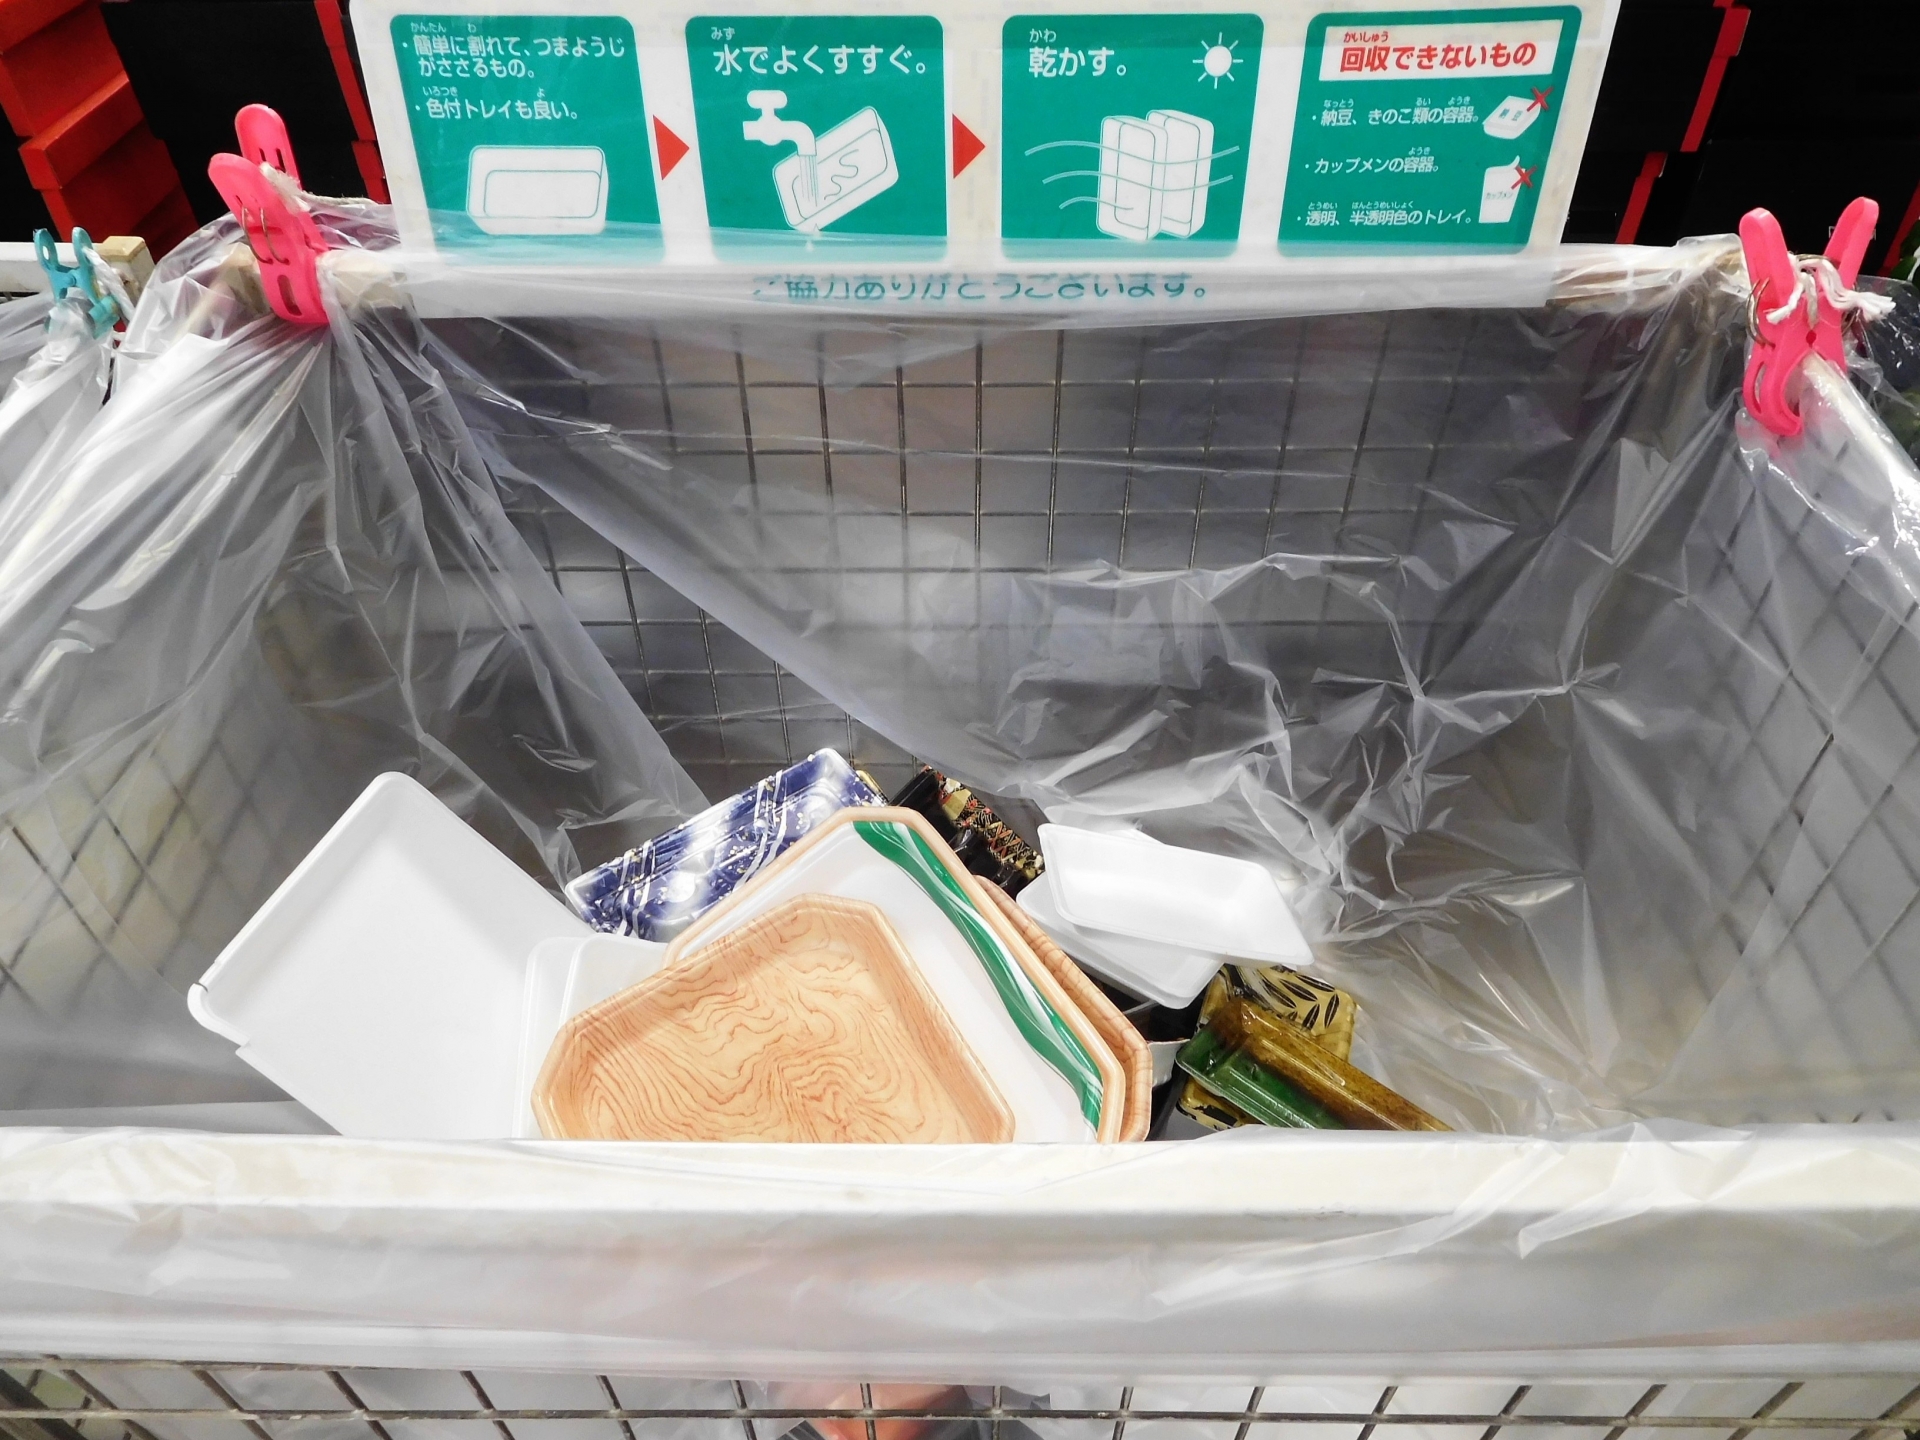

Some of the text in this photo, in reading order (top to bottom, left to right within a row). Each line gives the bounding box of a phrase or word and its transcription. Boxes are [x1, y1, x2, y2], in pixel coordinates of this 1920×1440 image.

[410, 22, 446, 32] かんたん
[711, 27, 735, 40] みず
[1029, 29, 1057, 43] かわ
[1343, 31, 1389, 43] かいしゅう
[413, 35, 625, 57] 簡単に割れて、つまようじ
[713, 44, 926, 75] 水でよくすすぐ。
[1029, 47, 1127, 77] 乾かす。
[1341, 42, 1536, 73] 回収できないもの
[419, 59, 534, 78] がささるもの。
[423, 87, 457, 96] いろつき
[426, 98, 577, 120] 色付トレイも良い。
[1323, 96, 1471, 108] なっとう るい ようき
[1321, 106, 1478, 126] 納豆、きのこ類の容器。
[1408, 147, 1431, 155] ようき
[1315, 156, 1439, 174] カップメンの容器。
[1306, 209, 1471, 226] 透明、半透明色のトレイ。
